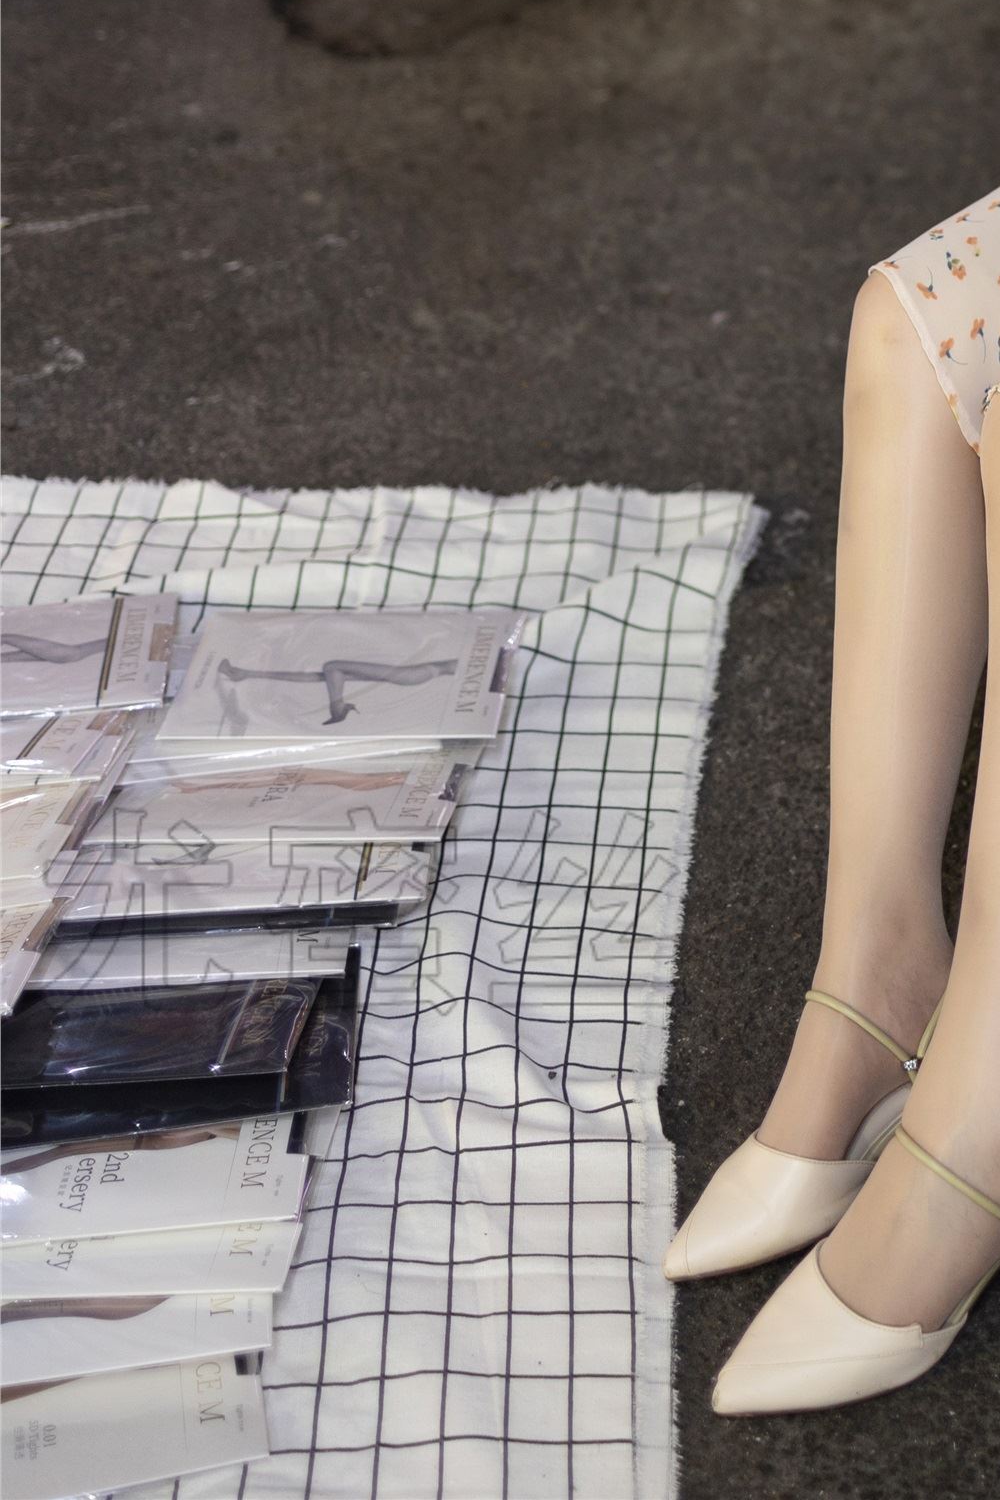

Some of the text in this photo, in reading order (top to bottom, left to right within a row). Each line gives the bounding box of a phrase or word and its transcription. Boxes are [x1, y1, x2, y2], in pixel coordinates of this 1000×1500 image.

[454, 625, 498, 714] LIMERENCE M
[398, 807, 422, 818] M
[296, 929, 321, 943] M
[240, 1117, 279, 1189] ENCE M
[99, 1152, 130, 1185] 2nd
[59, 1157, 97, 1212] ersery
[229, 1237, 258, 1256] M
[209, 1294, 236, 1317] M
[198, 1398, 226, 1426] M
